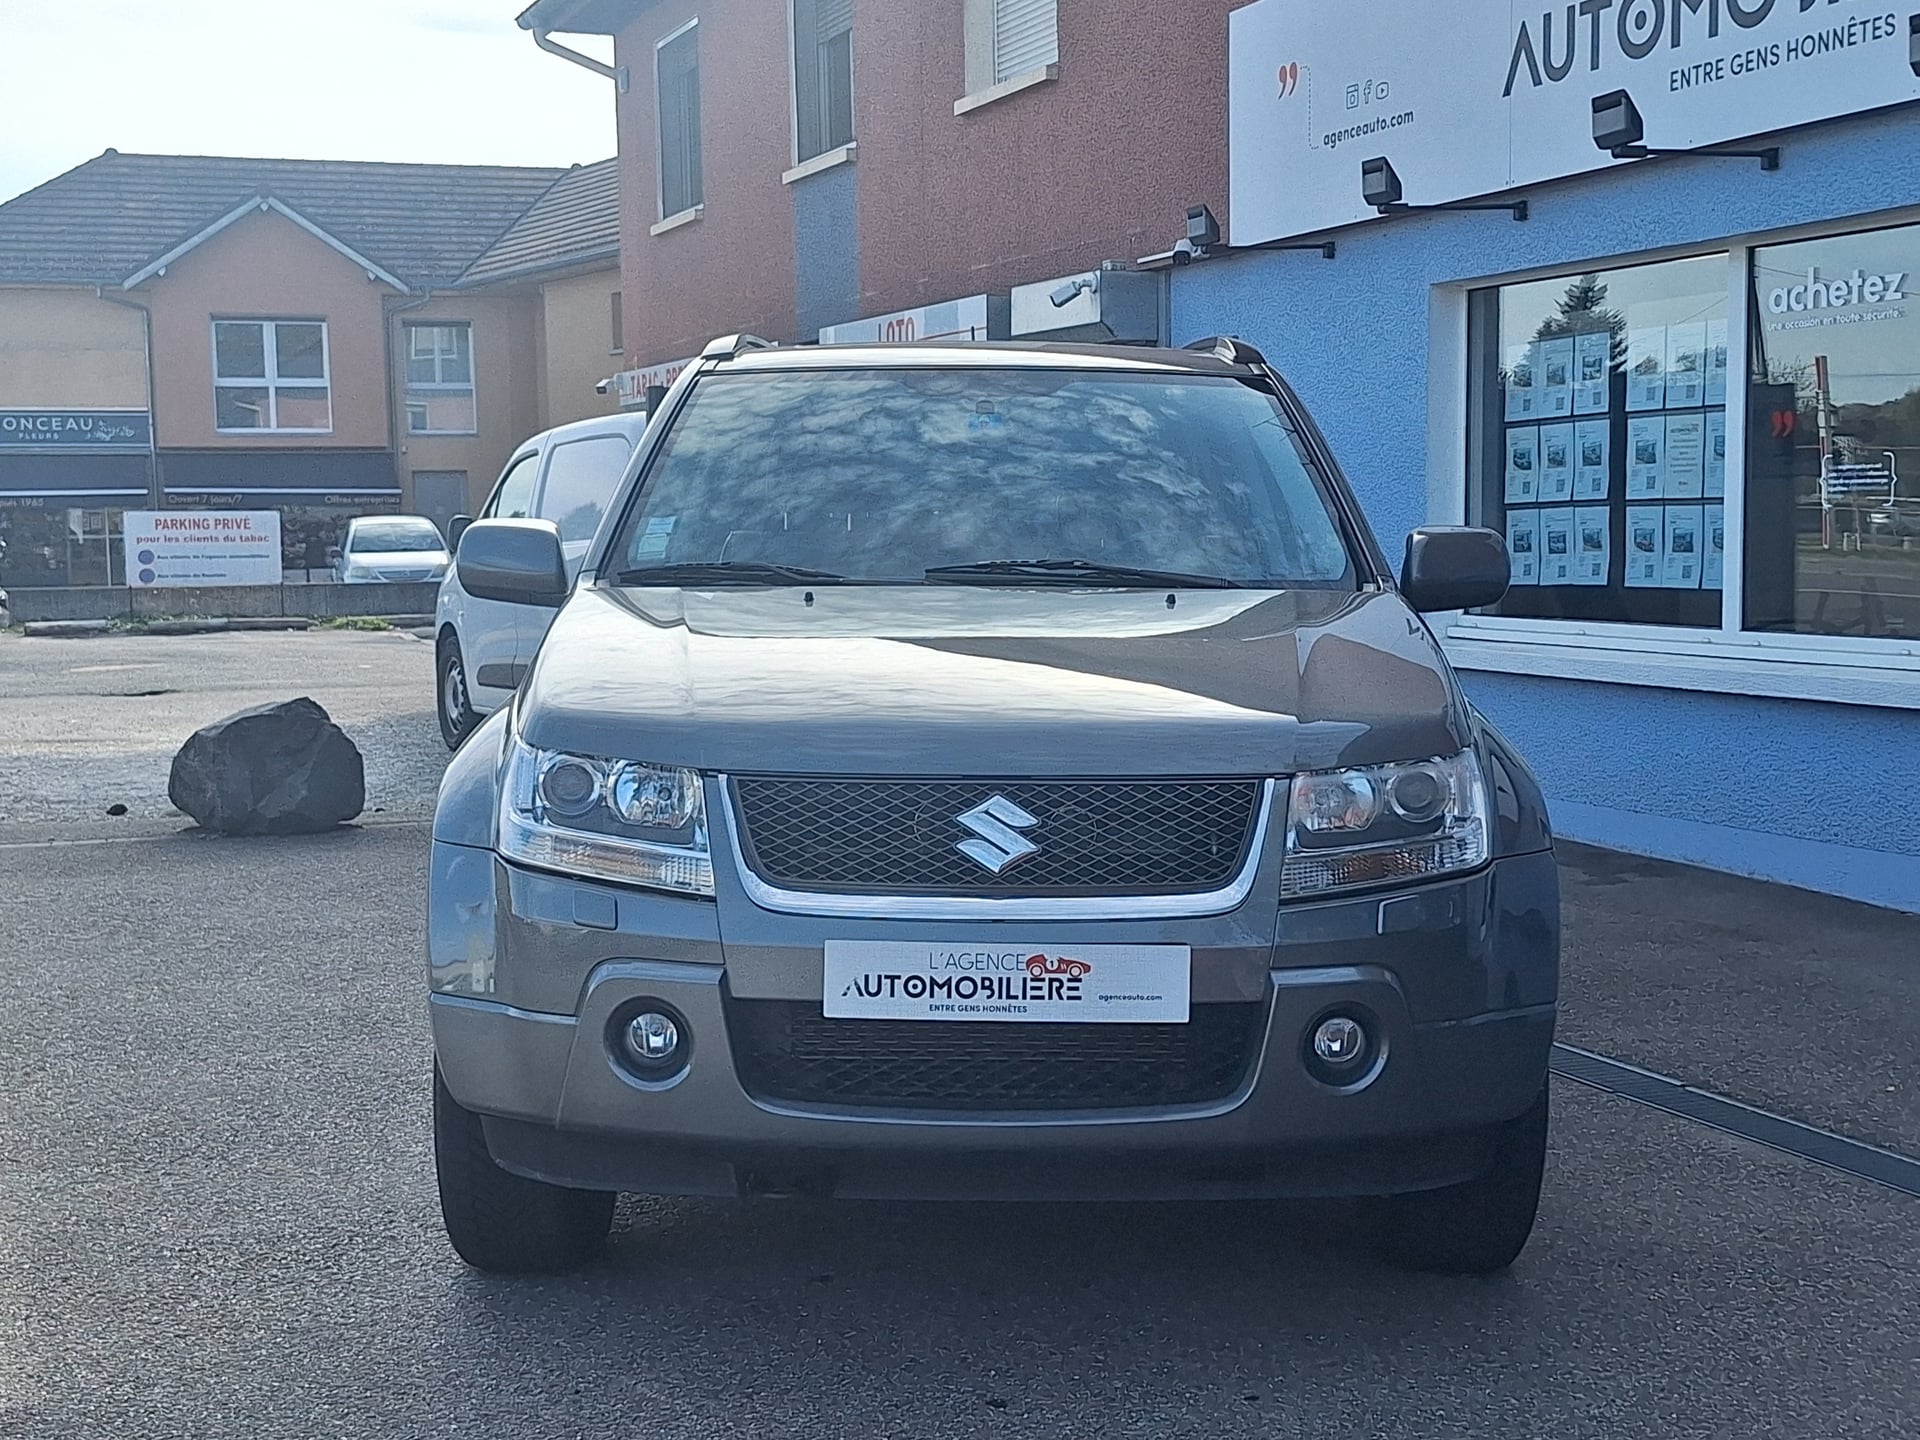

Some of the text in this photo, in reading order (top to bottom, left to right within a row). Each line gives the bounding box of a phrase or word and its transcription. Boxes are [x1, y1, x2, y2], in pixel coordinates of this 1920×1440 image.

[1502, 0, 1840, 97] AUTOM
[1669, 13, 1896, 92] ENTRE GENS HONNÊTES
[1323, 110, 1414, 149] agenceauto.com
[1768, 266, 1905, 314] achetez
[878, 317, 916, 342] LOTO
[1784, 316, 1820, 330] occasion
[1823, 316, 1834, 326] en
[1835, 313, 1860, 325] toute
[2, 417, 94, 431] ONCEAU
[18, 432, 60, 440] FLEURS
[154, 515, 252, 531] PARKING PRIVÉ
[136, 534, 270, 545] pour les clients du tabac
[929, 951, 1028, 972] L'AGENCE
[1097, 993, 1163, 1003] agenceauto.com
[929, 1003, 1028, 1014] ENTRE GENS HONNÊTES
